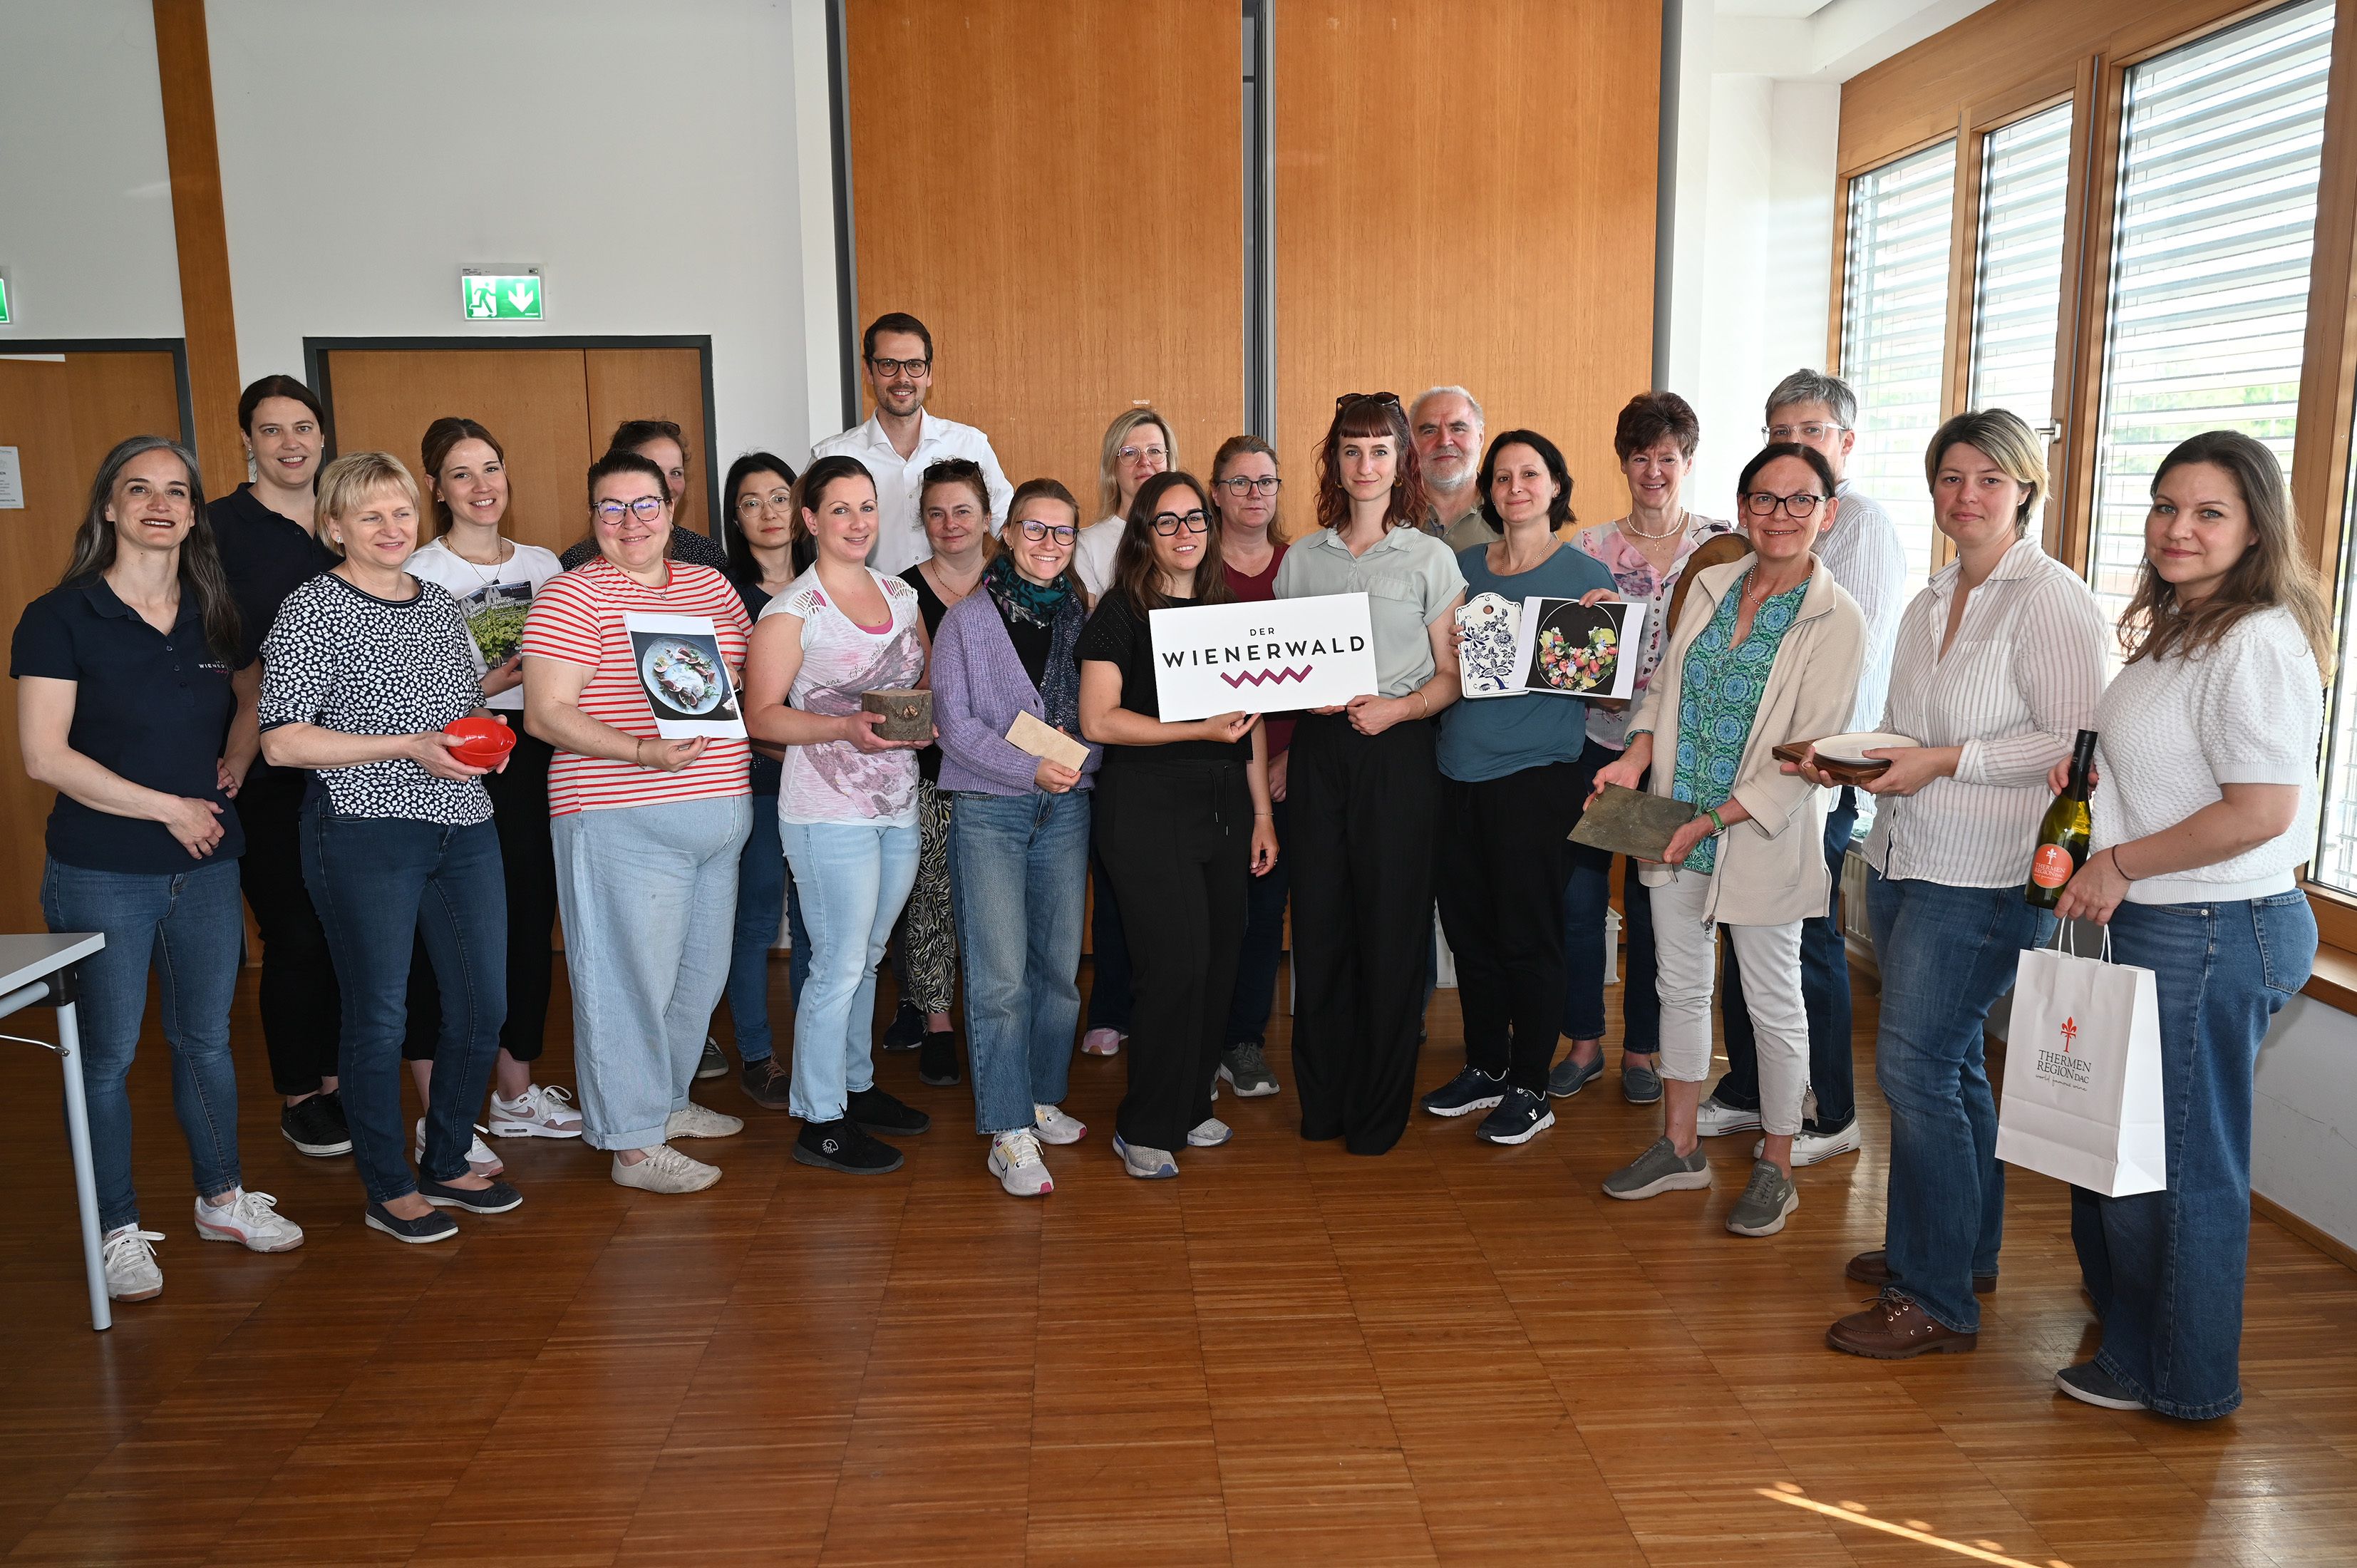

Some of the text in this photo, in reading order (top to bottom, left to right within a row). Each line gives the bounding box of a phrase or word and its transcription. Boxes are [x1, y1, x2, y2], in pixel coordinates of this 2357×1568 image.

[1249, 627, 1274, 636] DER
[1162, 635, 1365, 669] WIENERWALD
[2034, 867, 2054, 877] REGION
[2036, 862, 2065, 873] THERMEN
[2038, 1049, 2092, 1072] THERMEN
[2037, 1060, 2090, 1084] REGION DAC
